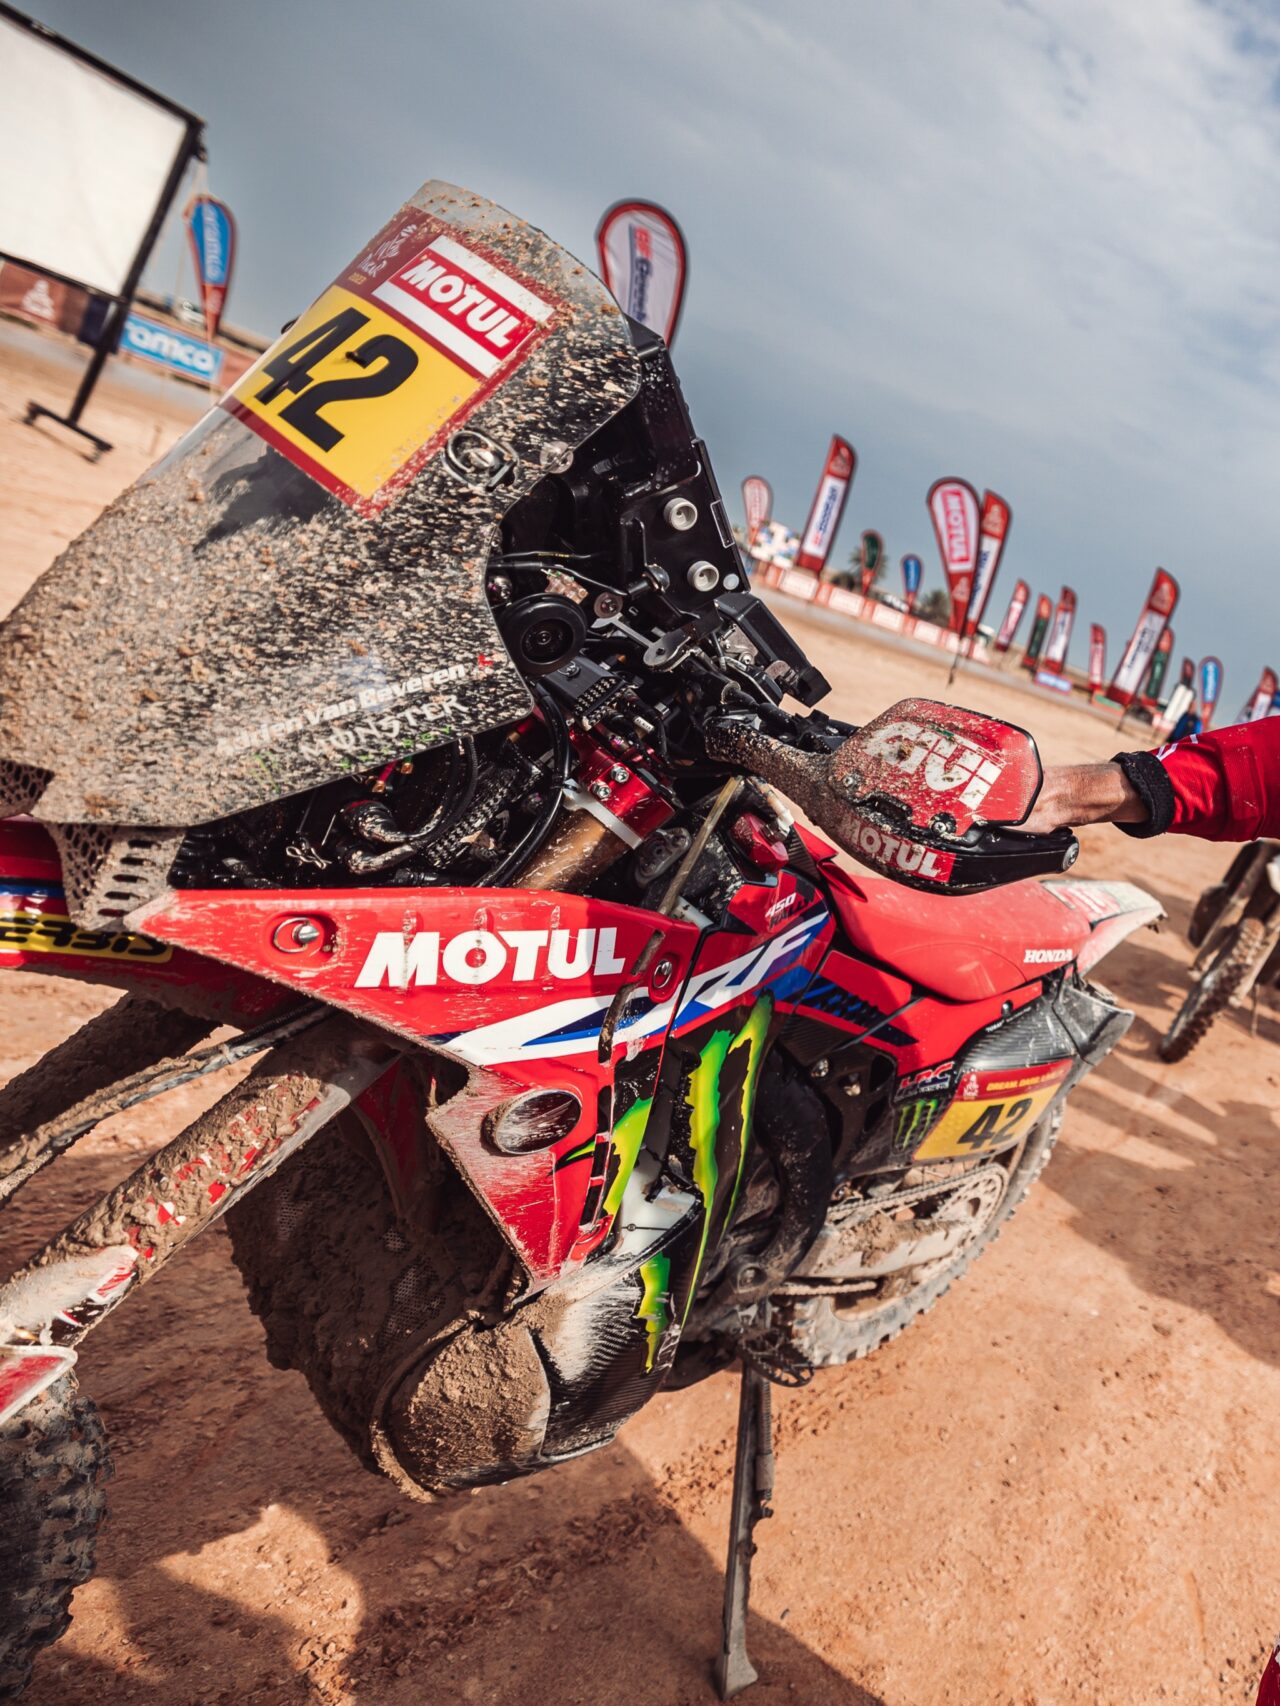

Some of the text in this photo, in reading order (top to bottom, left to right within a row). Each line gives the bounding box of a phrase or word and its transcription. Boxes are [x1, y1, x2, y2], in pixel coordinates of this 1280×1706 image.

[401, 258, 522, 349] MOTUL
[254, 307, 419, 453] 42
[945, 495, 967, 559] MOTUL
[302, 698, 357, 727] Van
[358, 663, 466, 709] Beveren
[765, 892, 796, 918] 450
[354, 928, 626, 988] MOTUL
[1023, 949, 1073, 963] HONDA
[956, 1098, 1034, 1150] 42
